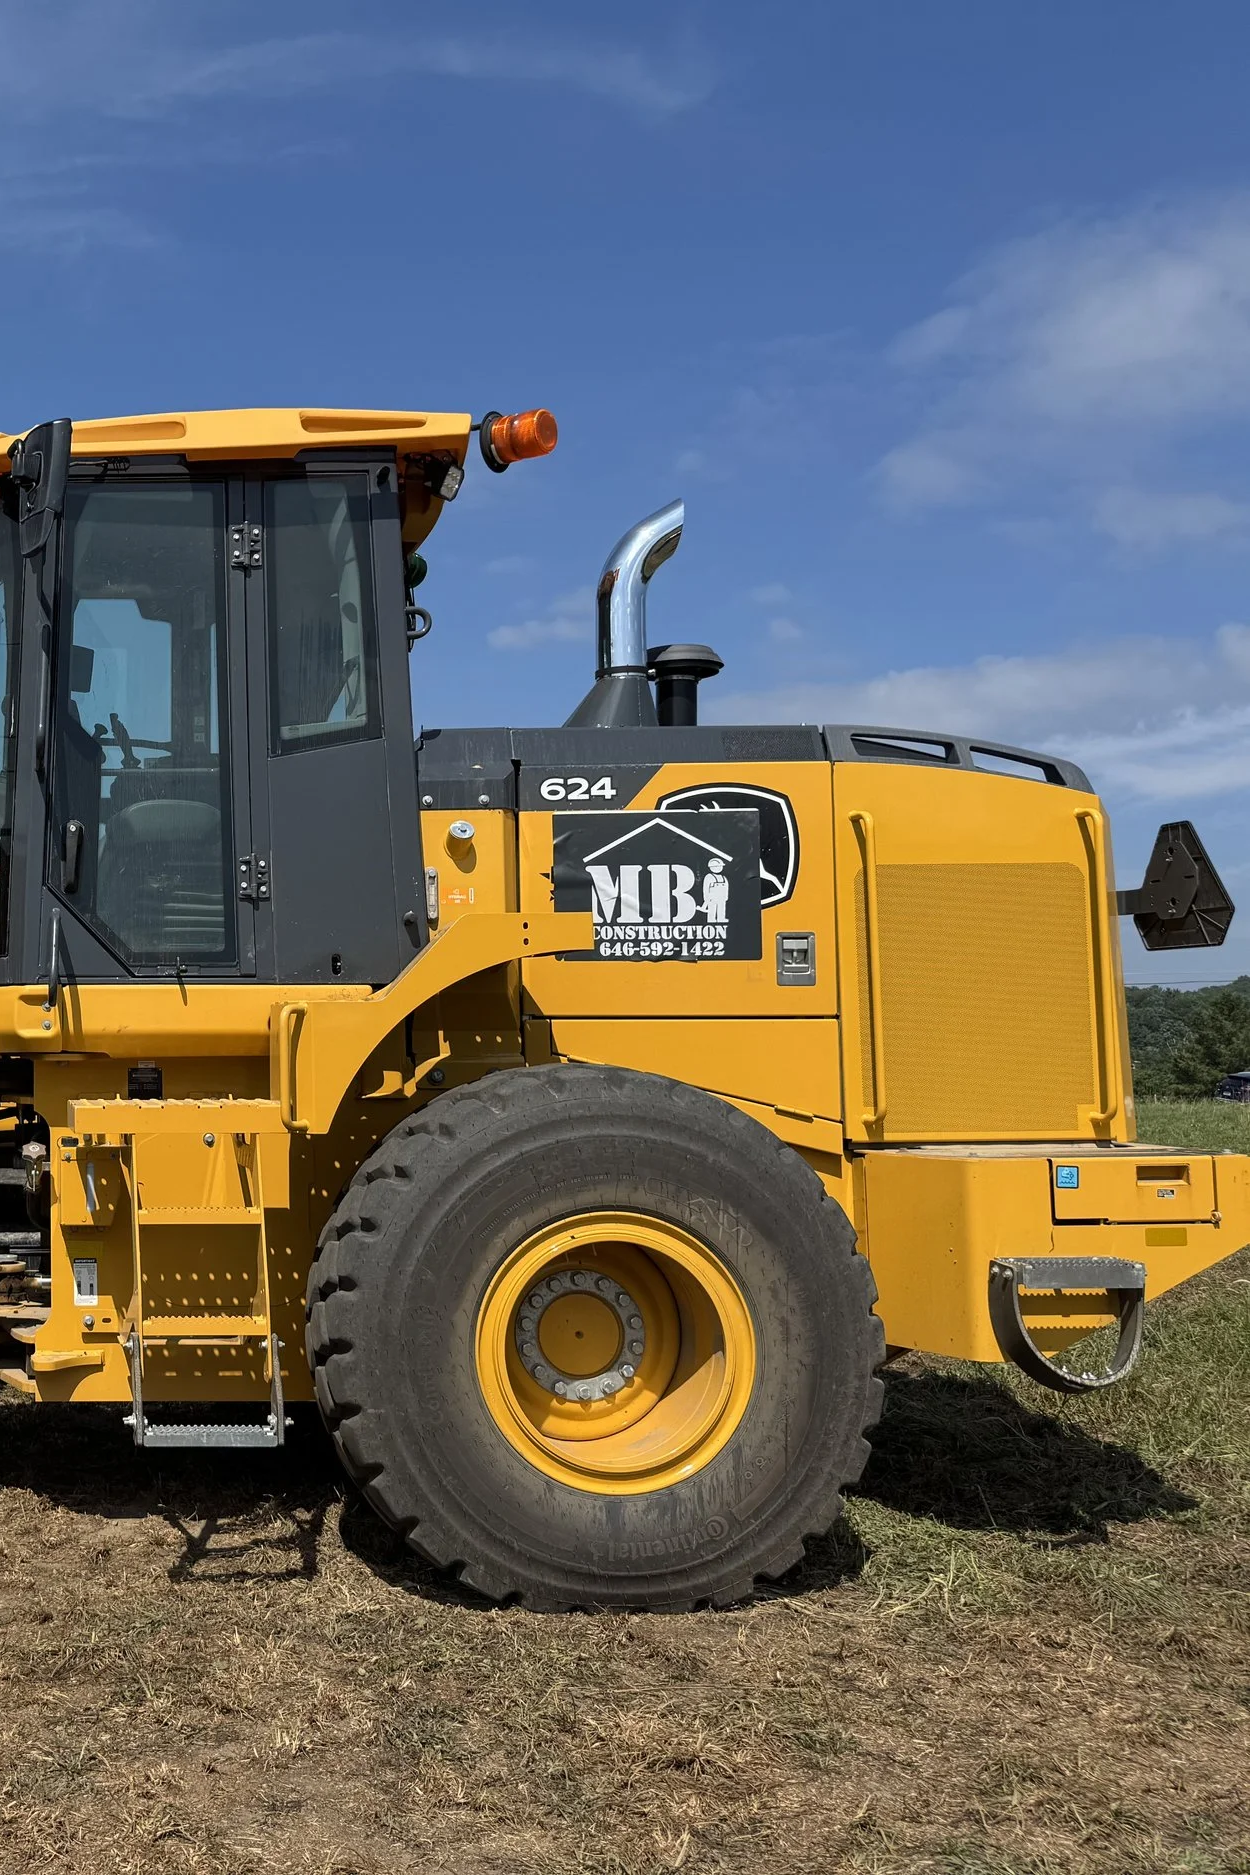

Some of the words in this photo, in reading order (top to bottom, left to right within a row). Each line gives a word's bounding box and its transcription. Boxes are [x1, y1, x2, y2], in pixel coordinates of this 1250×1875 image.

[539, 776, 617, 800] 624
[585, 864, 697, 924] MB
[592, 925, 729, 941] CONSTRUCTION
[599, 941, 726, 957] 646-592-1422
[607, 1514, 730, 1563] Continental
